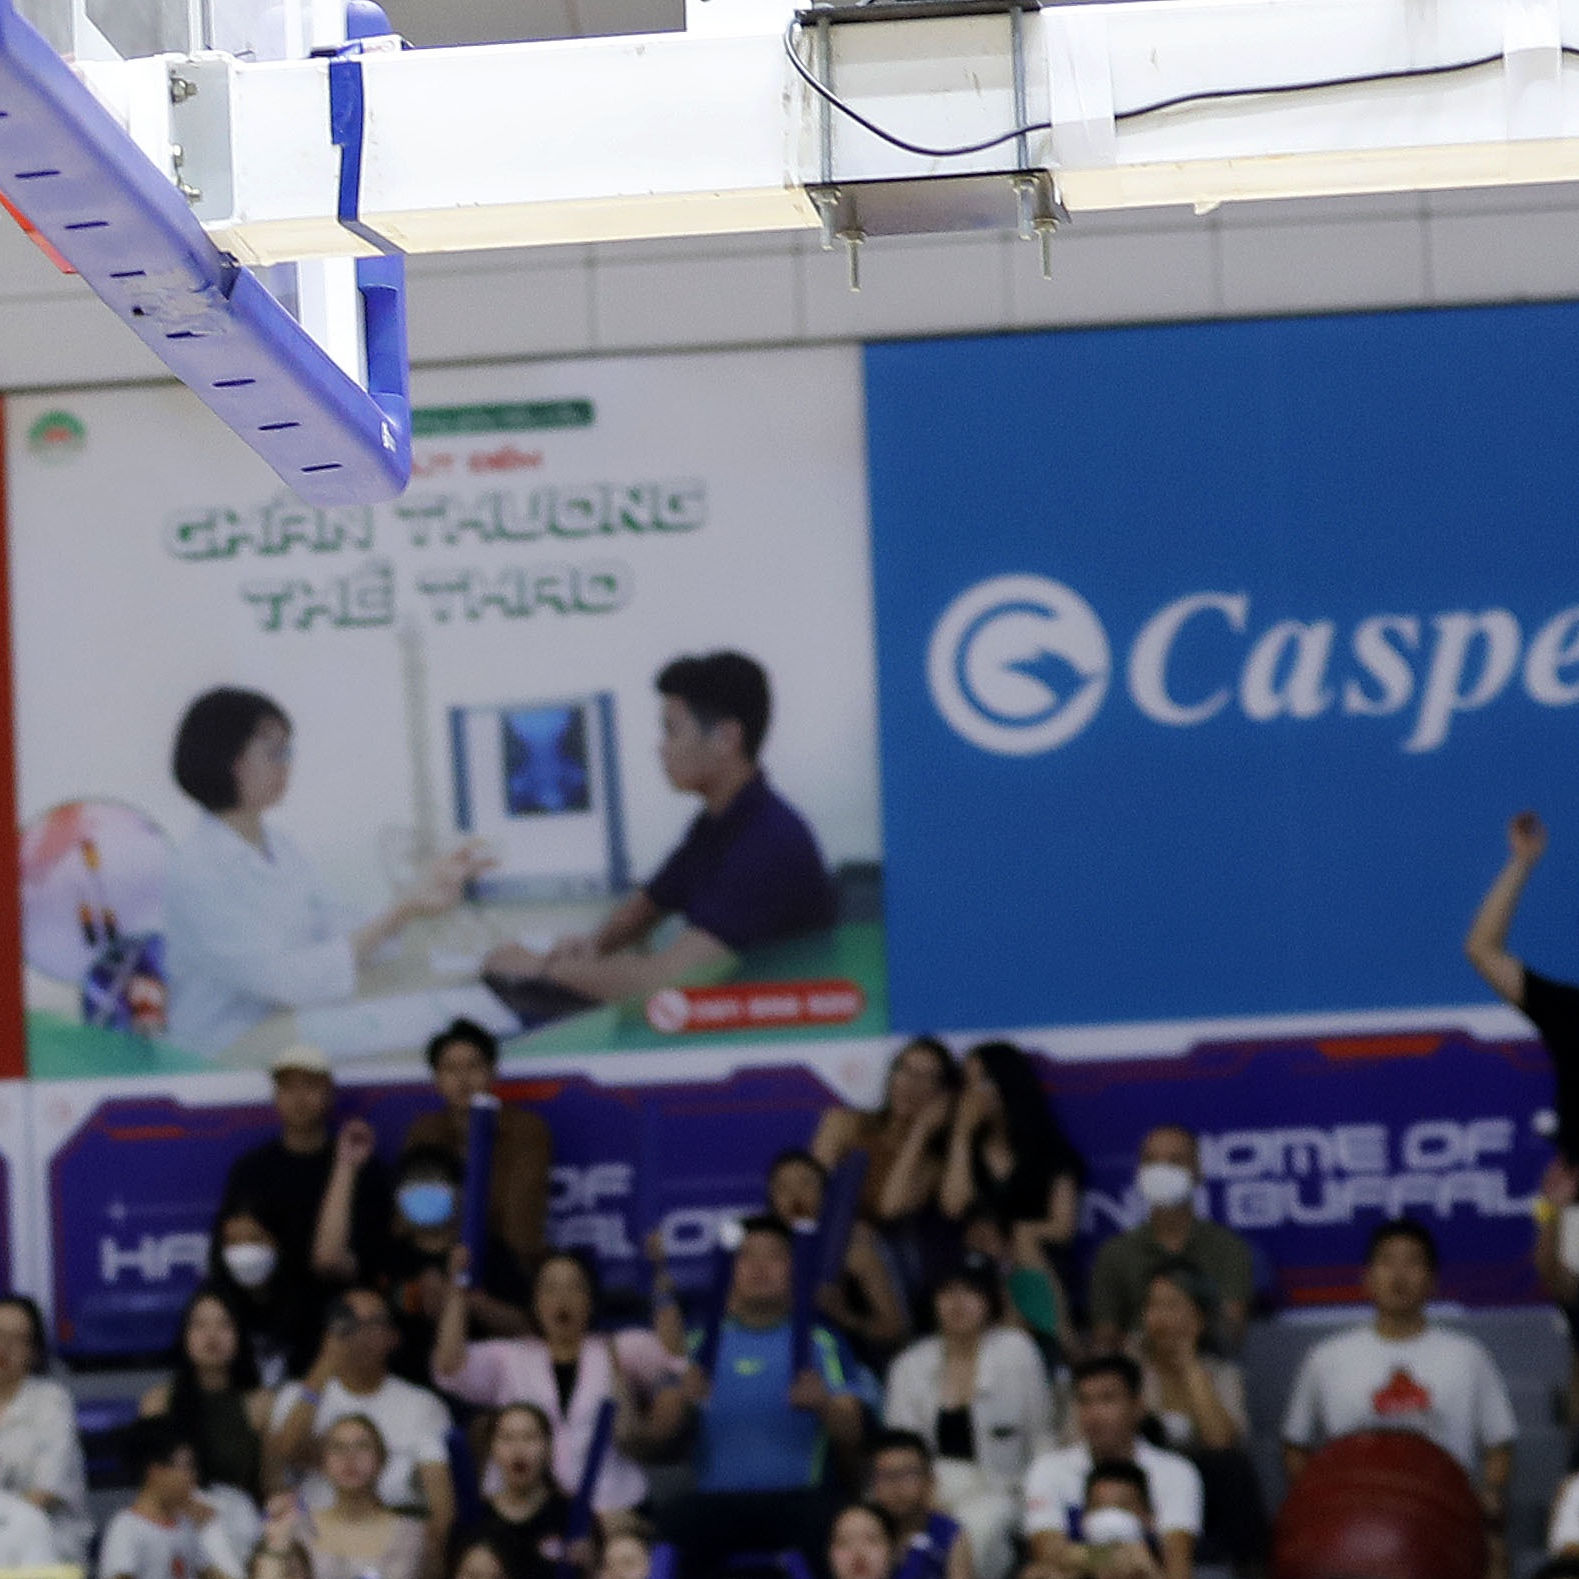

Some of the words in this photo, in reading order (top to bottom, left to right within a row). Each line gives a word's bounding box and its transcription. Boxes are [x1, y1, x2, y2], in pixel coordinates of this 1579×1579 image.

[1128, 592, 1579, 755] Caspe
[1403, 1117, 1515, 1170] OF
[1225, 1168, 1545, 1230] BUFFAL
